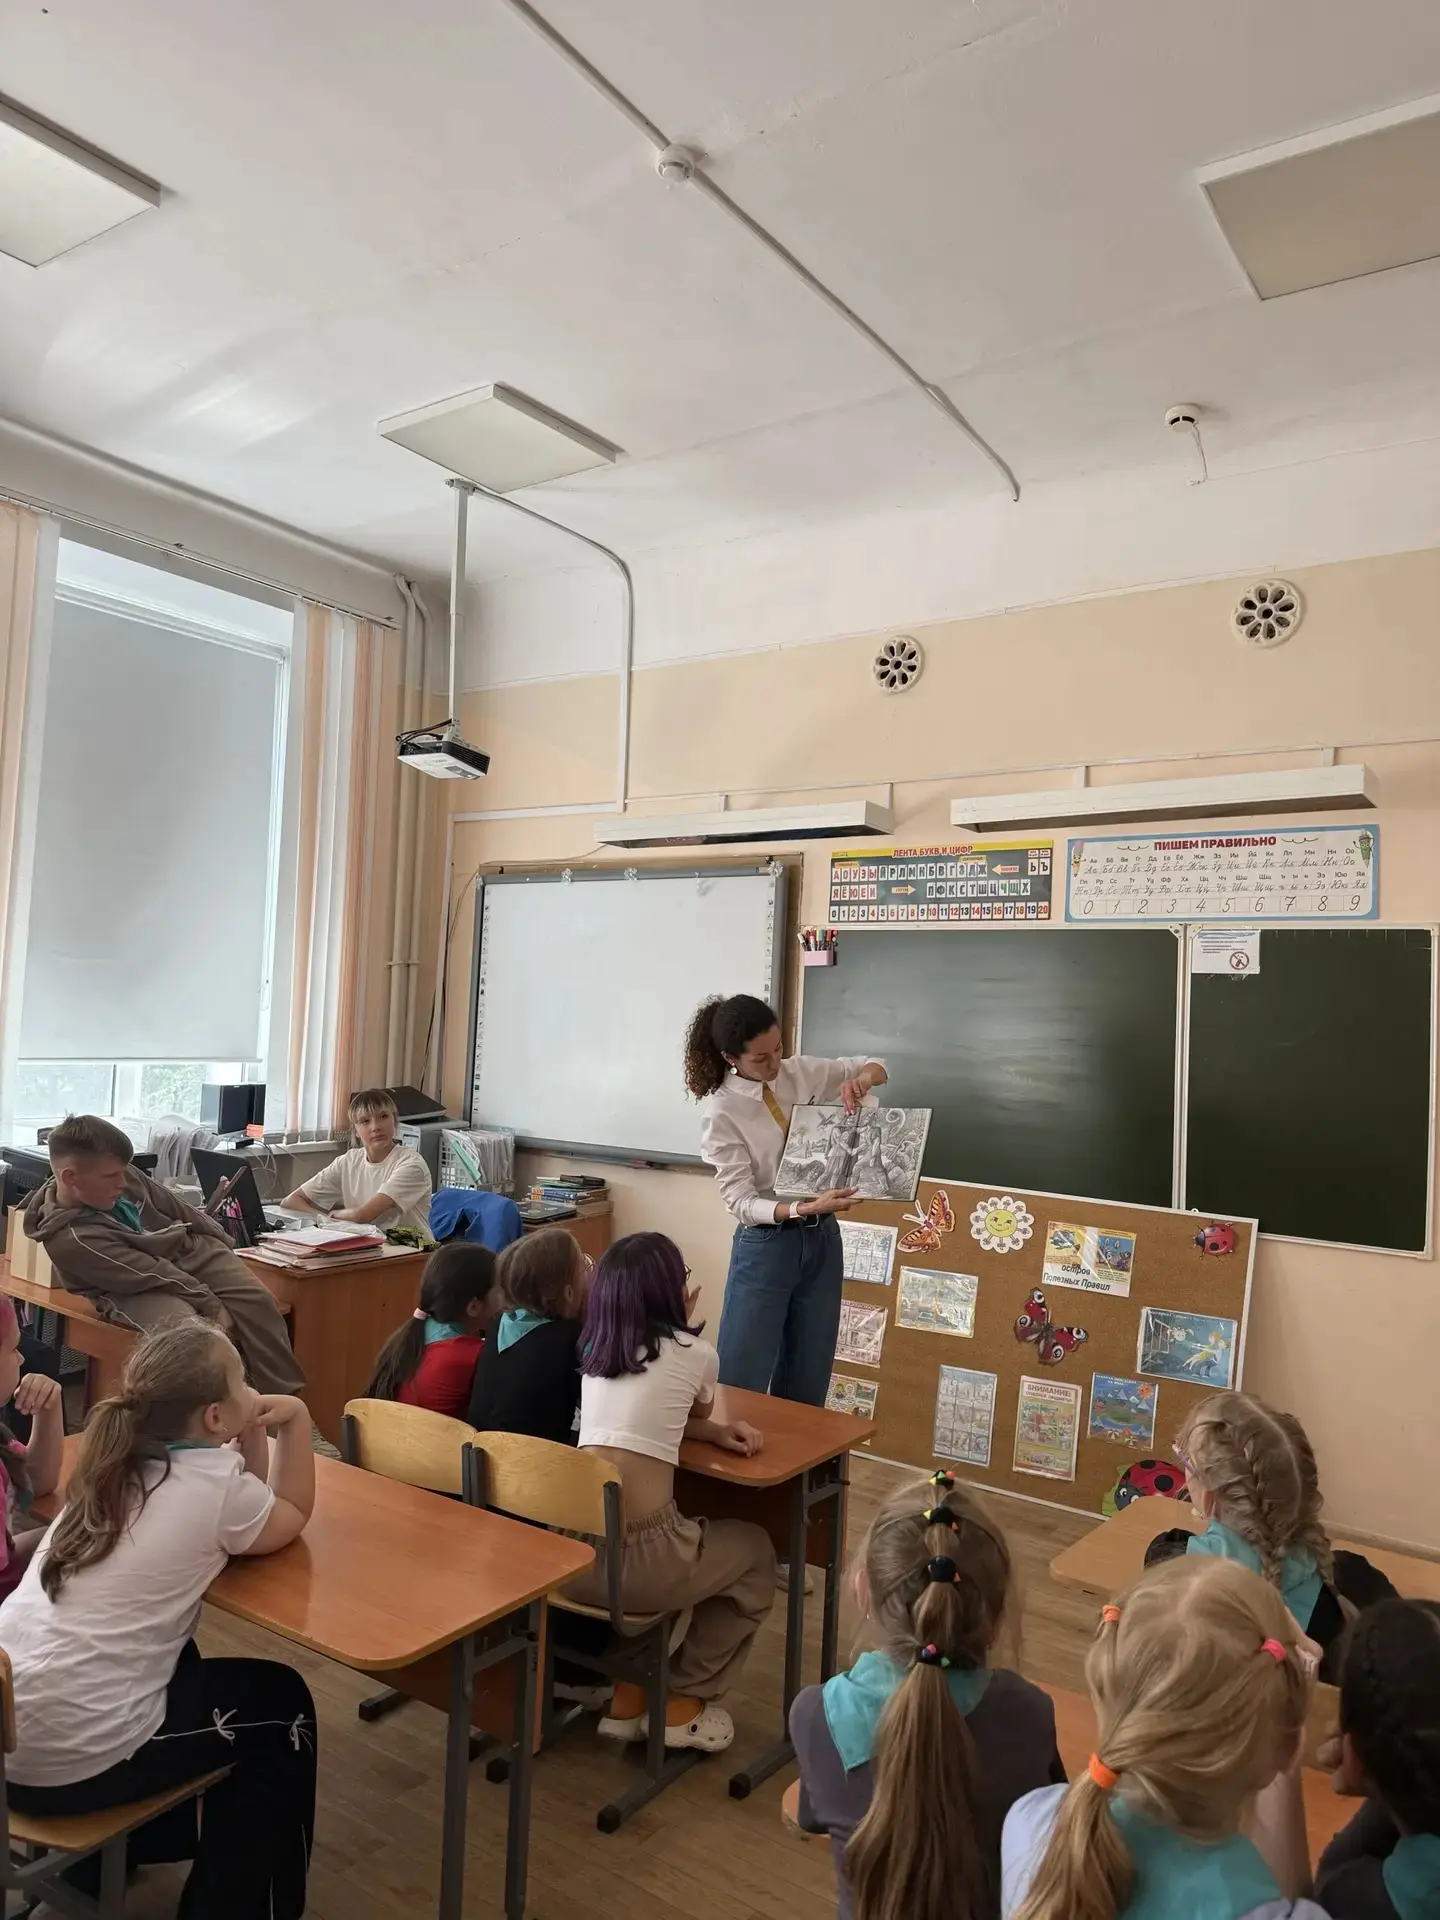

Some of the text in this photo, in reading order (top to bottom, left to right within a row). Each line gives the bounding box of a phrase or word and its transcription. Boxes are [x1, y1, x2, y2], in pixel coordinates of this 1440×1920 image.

[1154, 837, 1276, 850] ПИШЕМ ПРАВИЛЬНО
[894, 846, 972, 857] ЛЕНТА БУКВ И ЦИФР
[1038, 906, 1048, 914] 20
[1084, 895, 1360, 914] 0 1 2 3 4 5 6 7 8 9
[1062, 1265, 1090, 1275] остров
[1044, 1273, 1110, 1291] Полезных Правил
